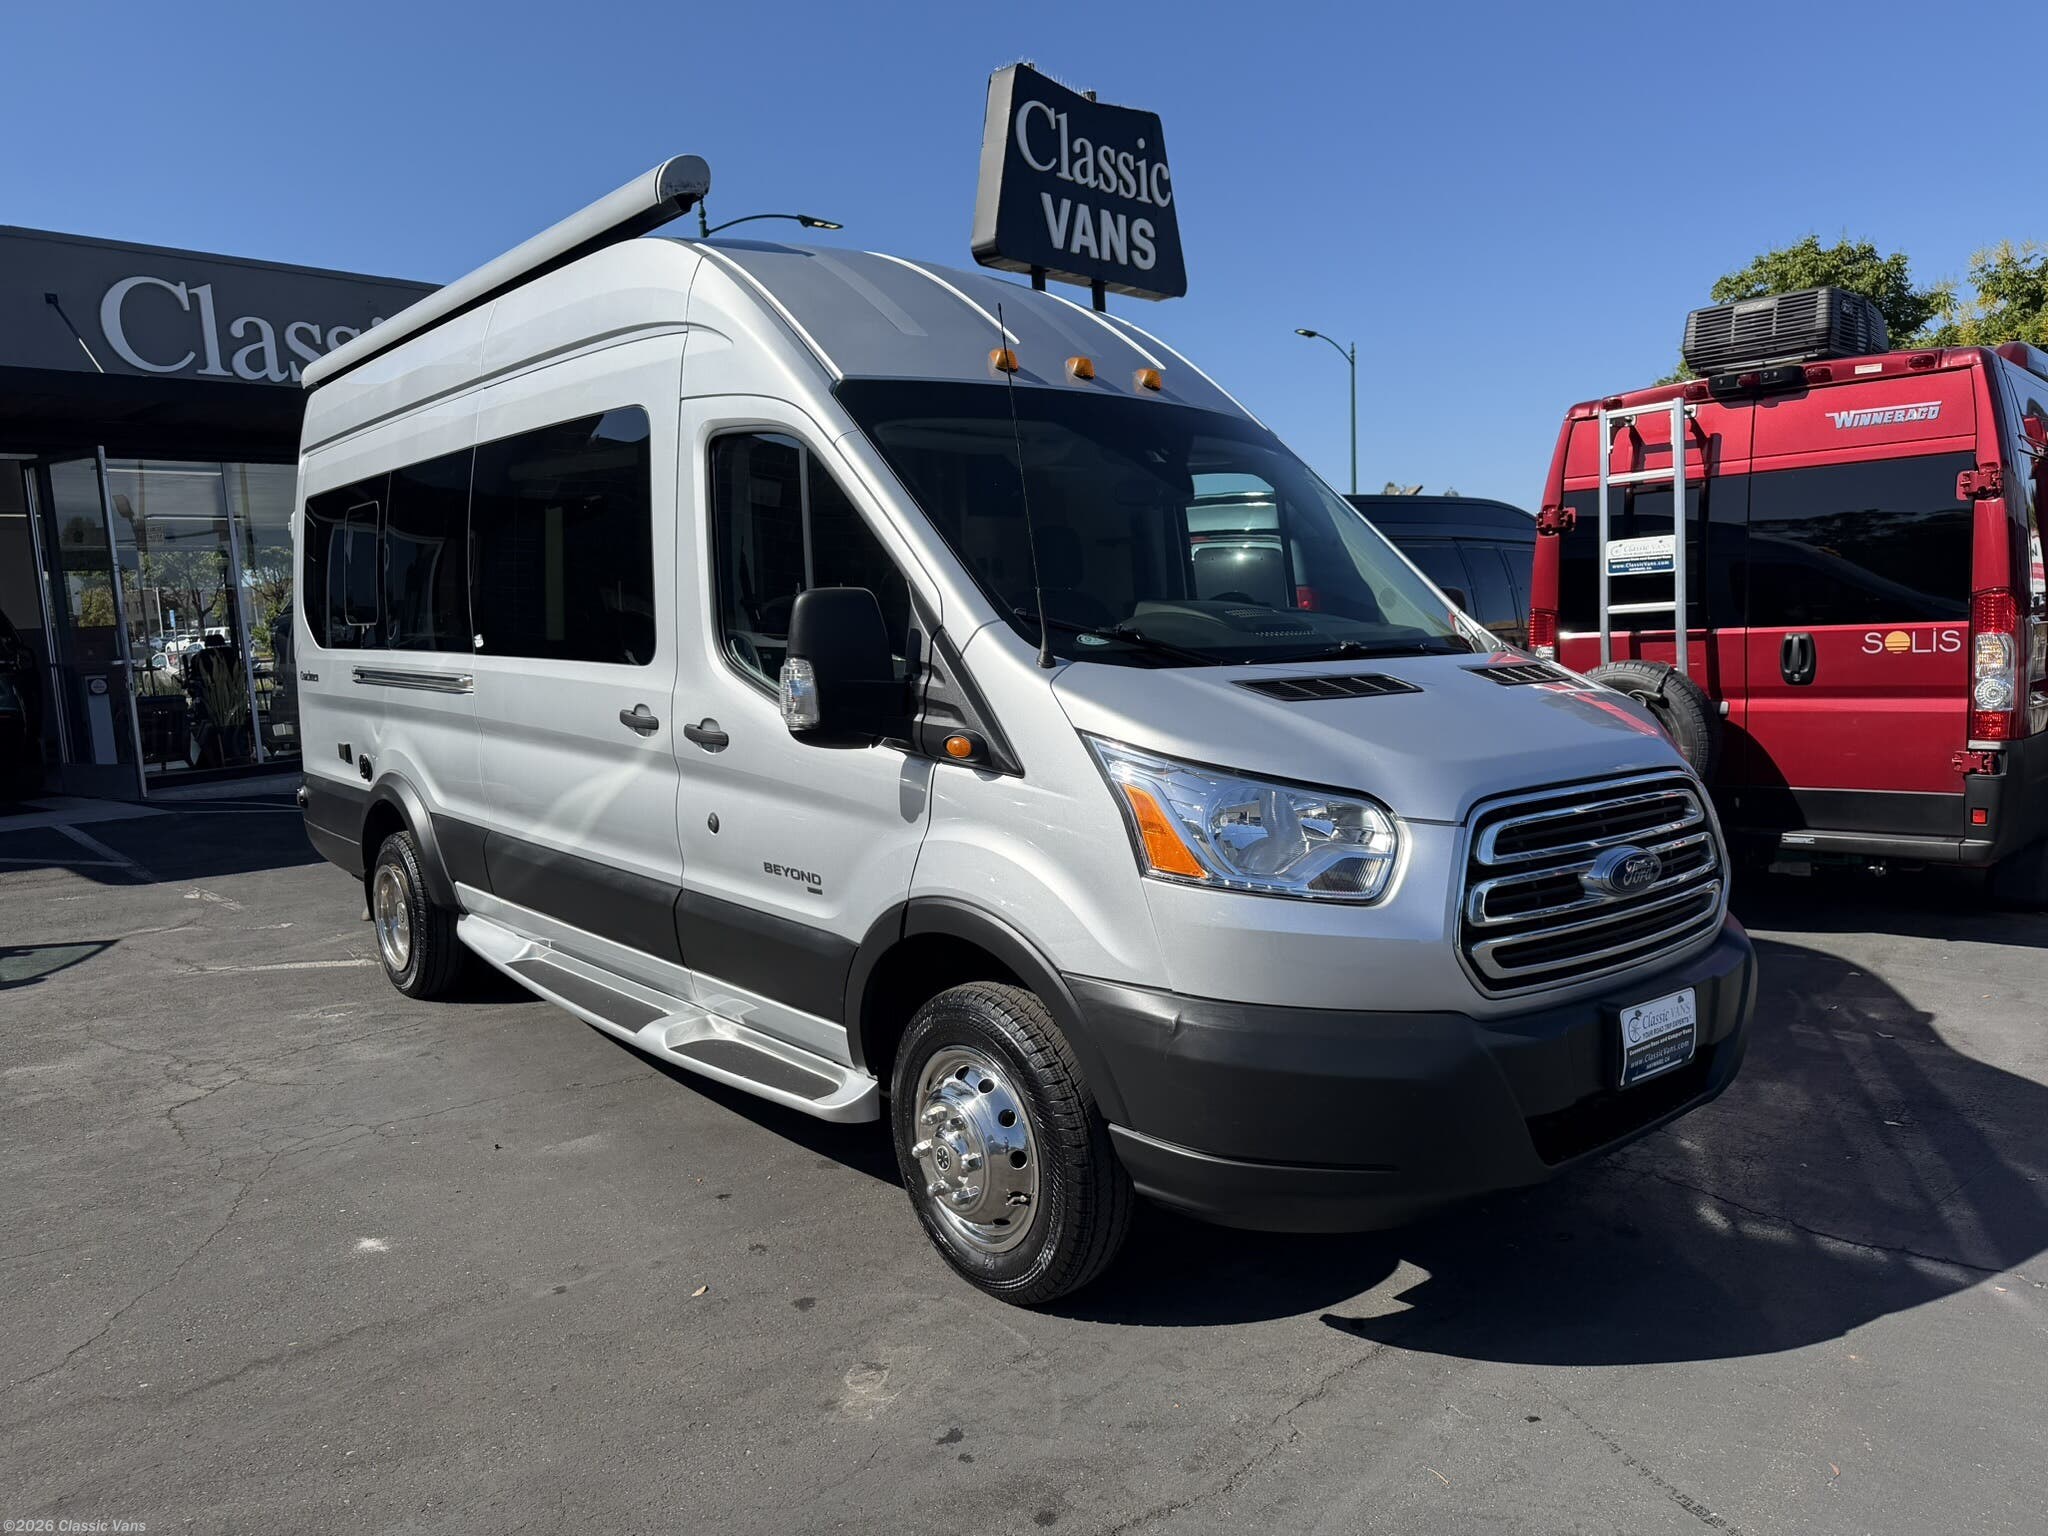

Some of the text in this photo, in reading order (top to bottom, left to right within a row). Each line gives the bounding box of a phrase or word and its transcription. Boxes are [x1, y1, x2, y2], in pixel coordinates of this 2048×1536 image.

[1015, 100, 1172, 208] Classic
[1040, 192, 1156, 271] VANS
[100, 276, 382, 383] Clas
[1826, 401, 1942, 429] WINNEBAGO
[763, 861, 822, 886] BEYOND
[1642, 1009, 1669, 1029] Classic
